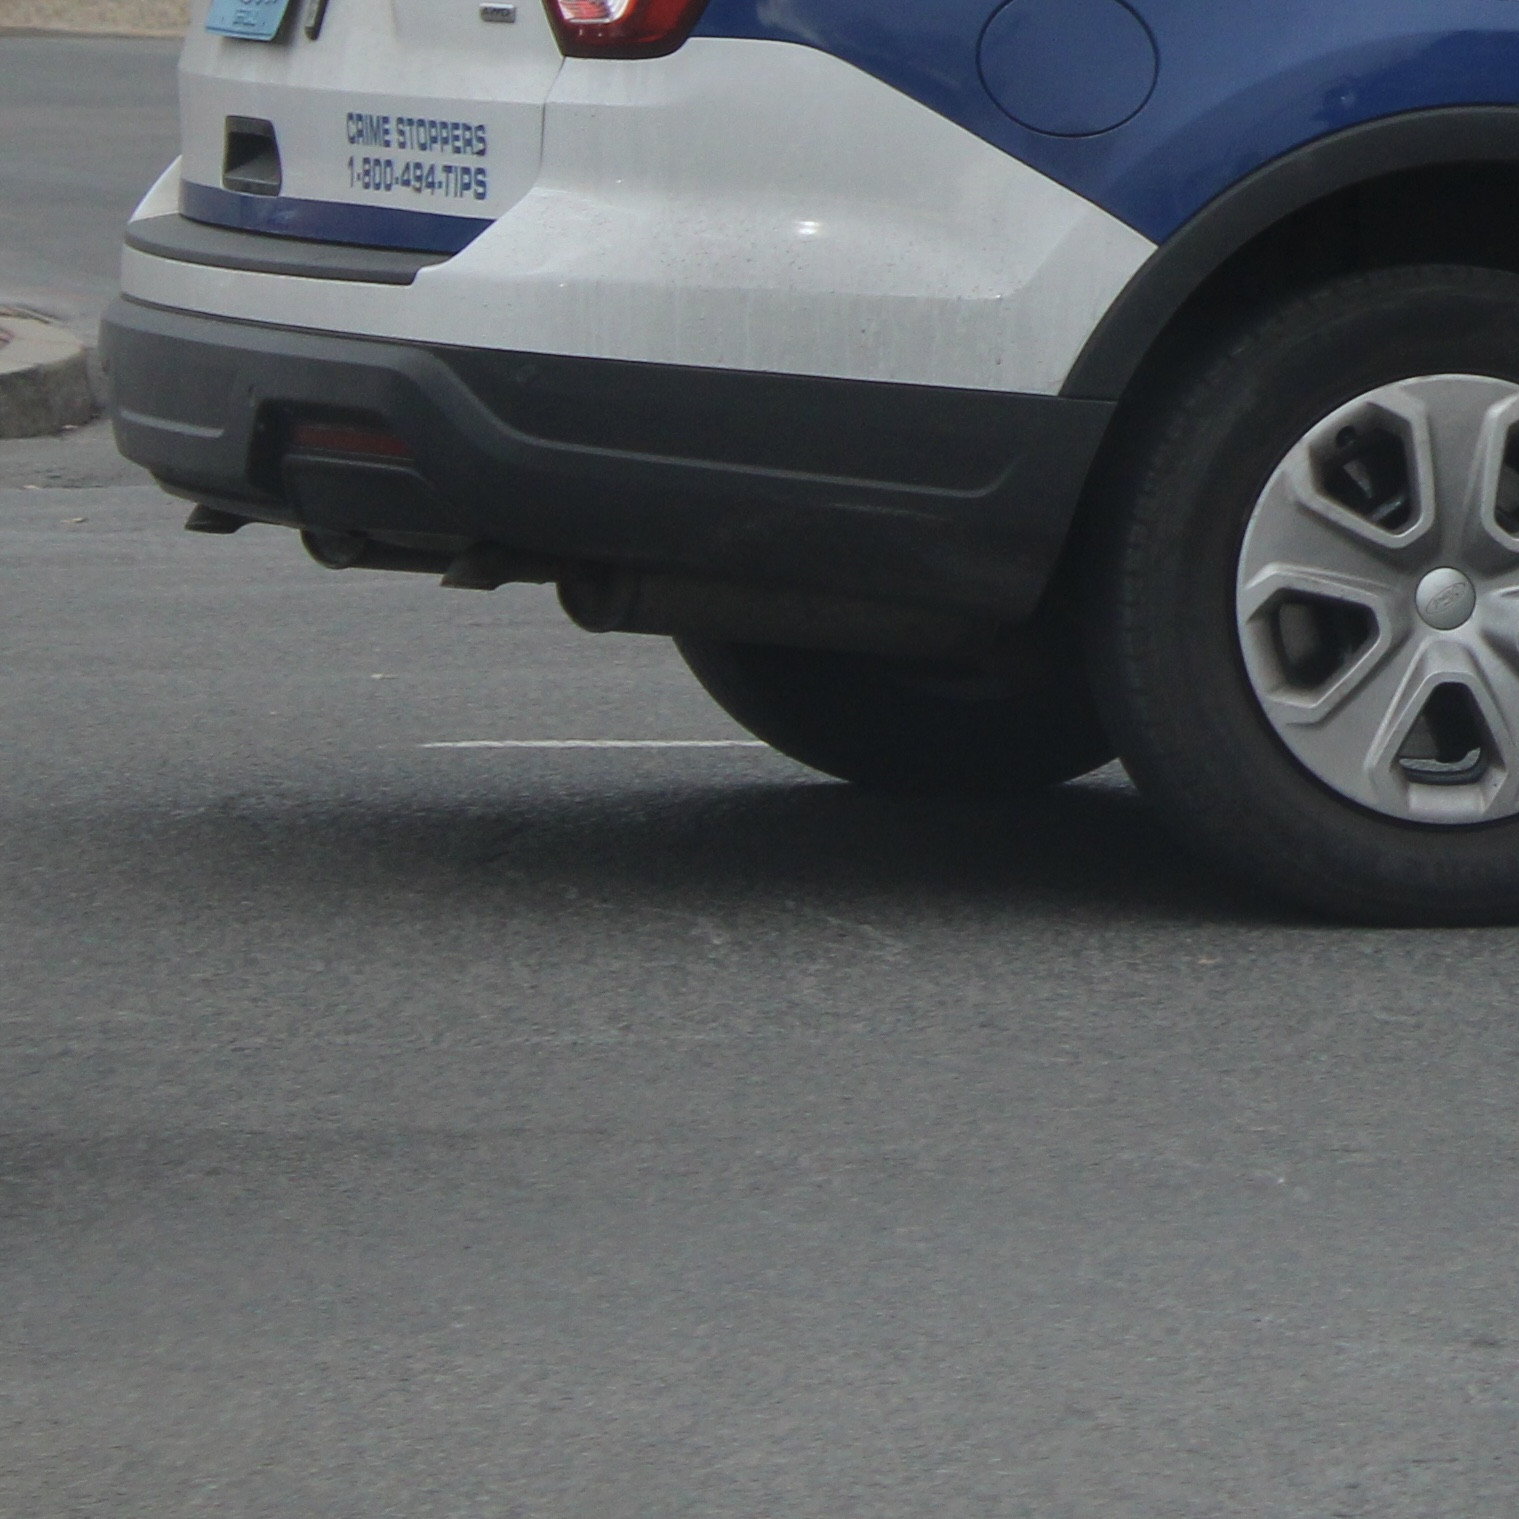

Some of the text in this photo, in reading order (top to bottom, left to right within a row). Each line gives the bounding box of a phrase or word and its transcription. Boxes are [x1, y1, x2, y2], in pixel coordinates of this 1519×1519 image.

[346, 112, 487, 157] CRIME STOPPERS
[347, 155, 487, 200] 1-800-494-TIPS
